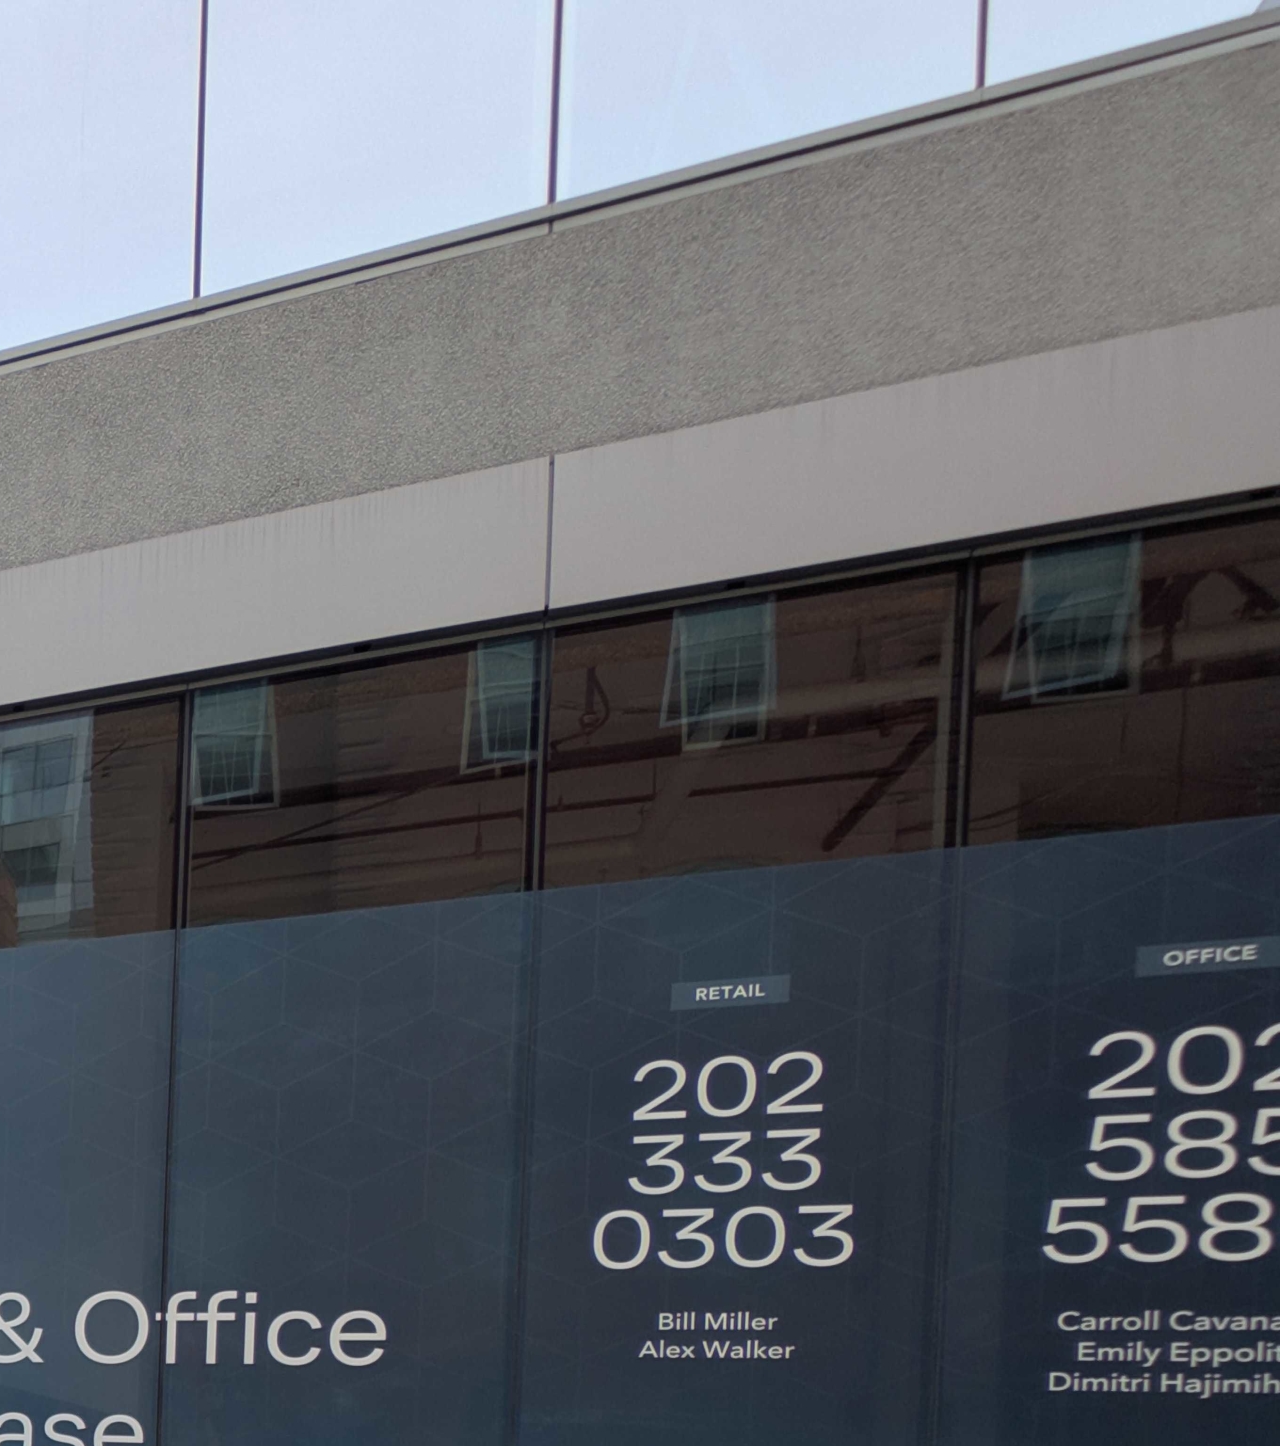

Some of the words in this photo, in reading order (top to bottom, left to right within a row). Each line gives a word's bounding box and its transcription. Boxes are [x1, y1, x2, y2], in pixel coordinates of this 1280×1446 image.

[1162, 944, 1259, 967] OFFICE
[695, 983, 766, 1001] RETAIL
[633, 1051, 823, 1121] 202
[628, 1128, 821, 1195] 333
[593, 1204, 854, 1270] 0303
[1041, 1192, 1274, 1264] 558
[75, 1290, 387, 1366] Office
[658, 1312, 696, 1331] Bill
[704, 1312, 778, 1331] Miller
[1057, 1310, 1161, 1331] Carroll
[638, 1340, 696, 1359] Alex
[702, 1340, 795, 1359] Walker
[1077, 1341, 1161, 1367] Emily
[1048, 1372, 1151, 1392] Dimitri
